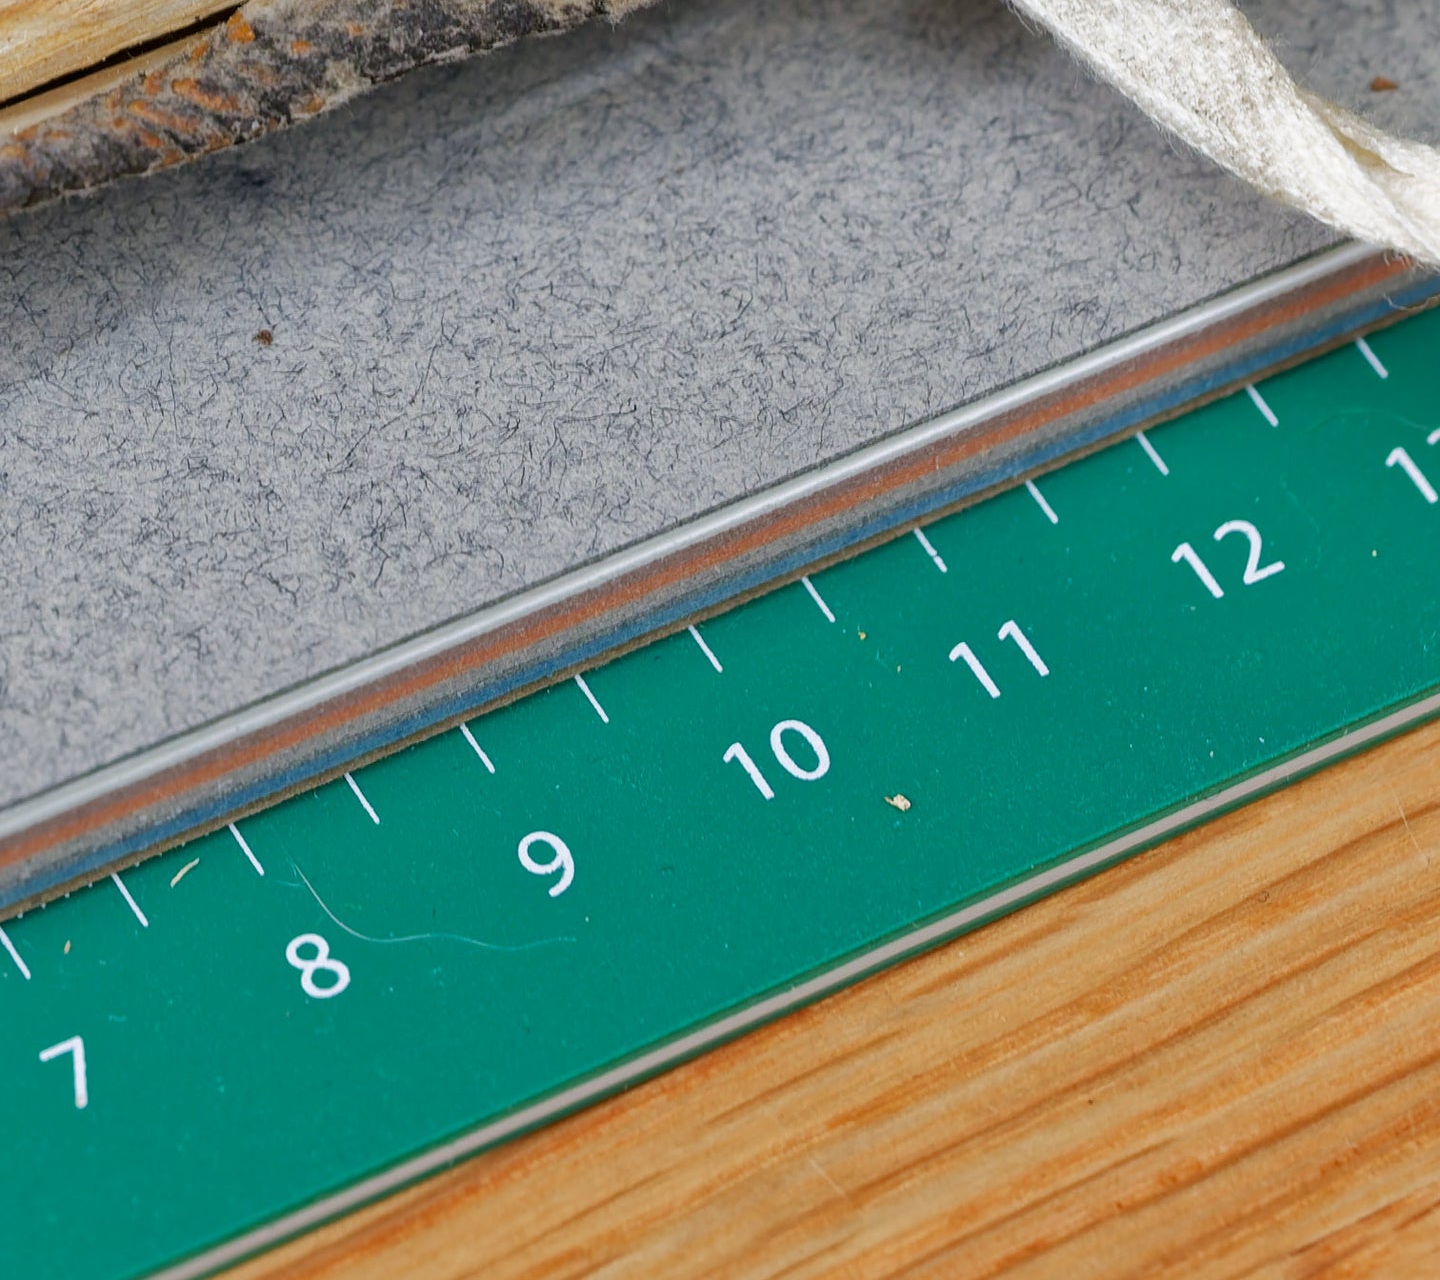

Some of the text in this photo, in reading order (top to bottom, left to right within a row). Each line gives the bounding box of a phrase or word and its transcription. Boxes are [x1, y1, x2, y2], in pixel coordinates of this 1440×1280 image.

[39, 1035, 88, 1109] 7
[285, 933, 351, 999] 8
[517, 831, 575, 897] 9
[722, 719, 831, 800] 10
[948, 619, 1050, 699] 11
[1171, 520, 1285, 599] 12
